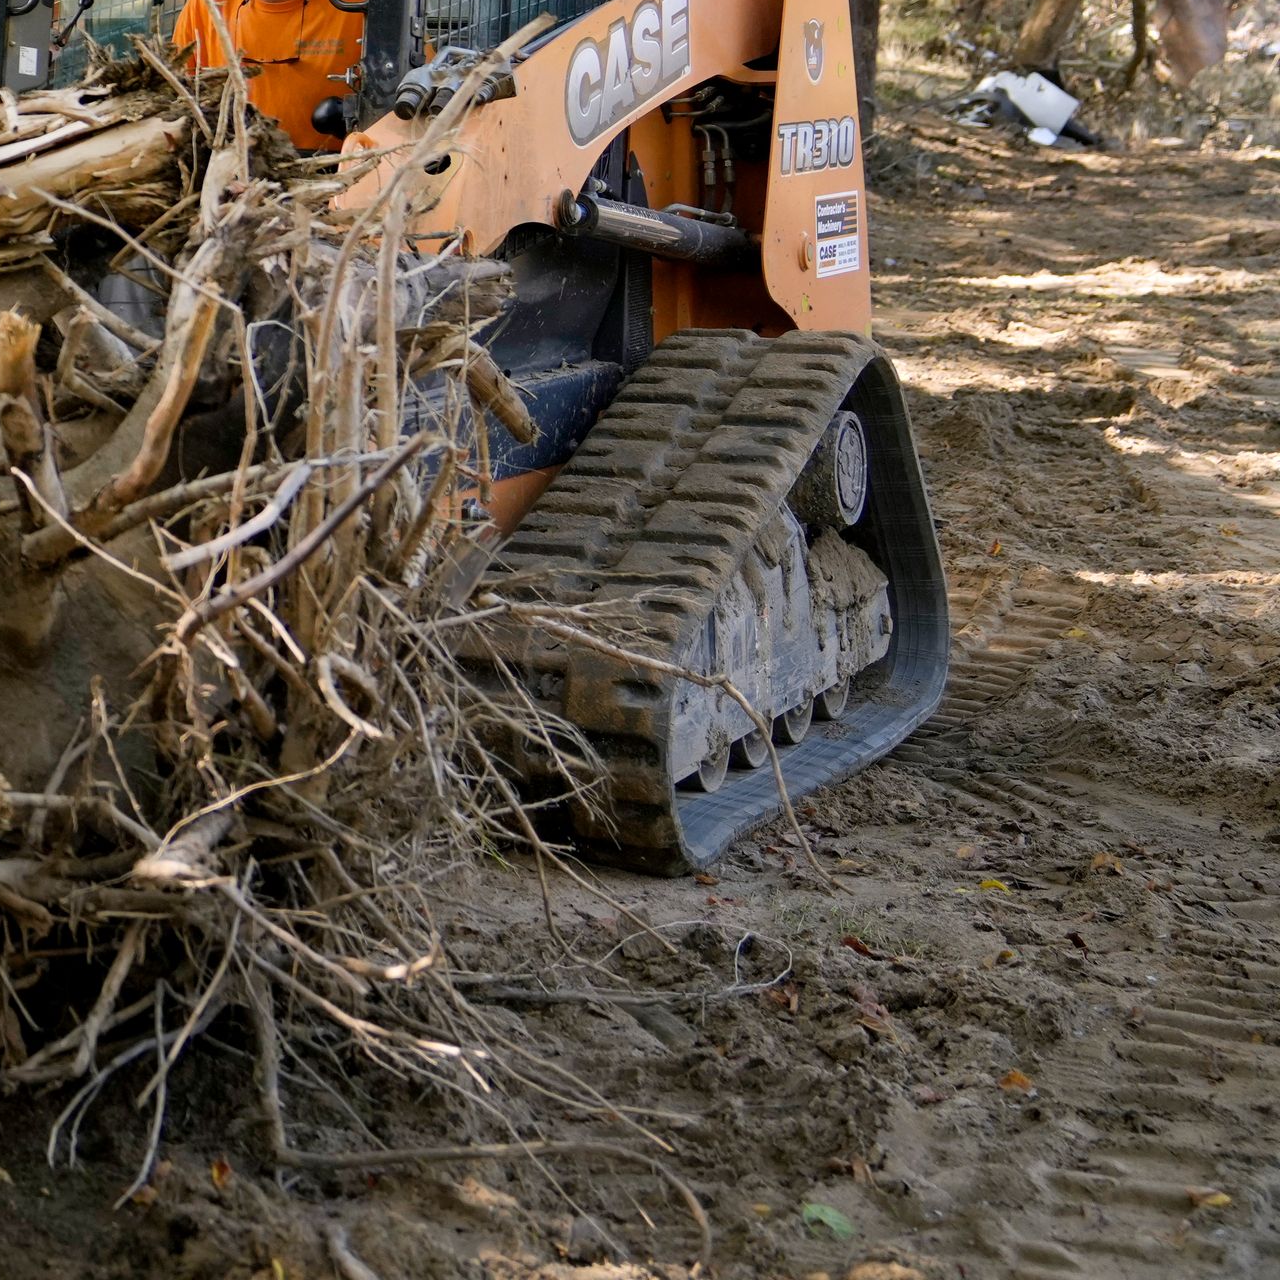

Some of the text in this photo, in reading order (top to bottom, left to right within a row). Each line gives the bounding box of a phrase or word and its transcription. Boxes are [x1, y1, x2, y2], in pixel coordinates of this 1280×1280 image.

[778, 116, 855, 175] TR310
[817, 201, 846, 217] Contractor's
[817, 220, 842, 233] Machinery
[819, 244, 837, 260] CASE
